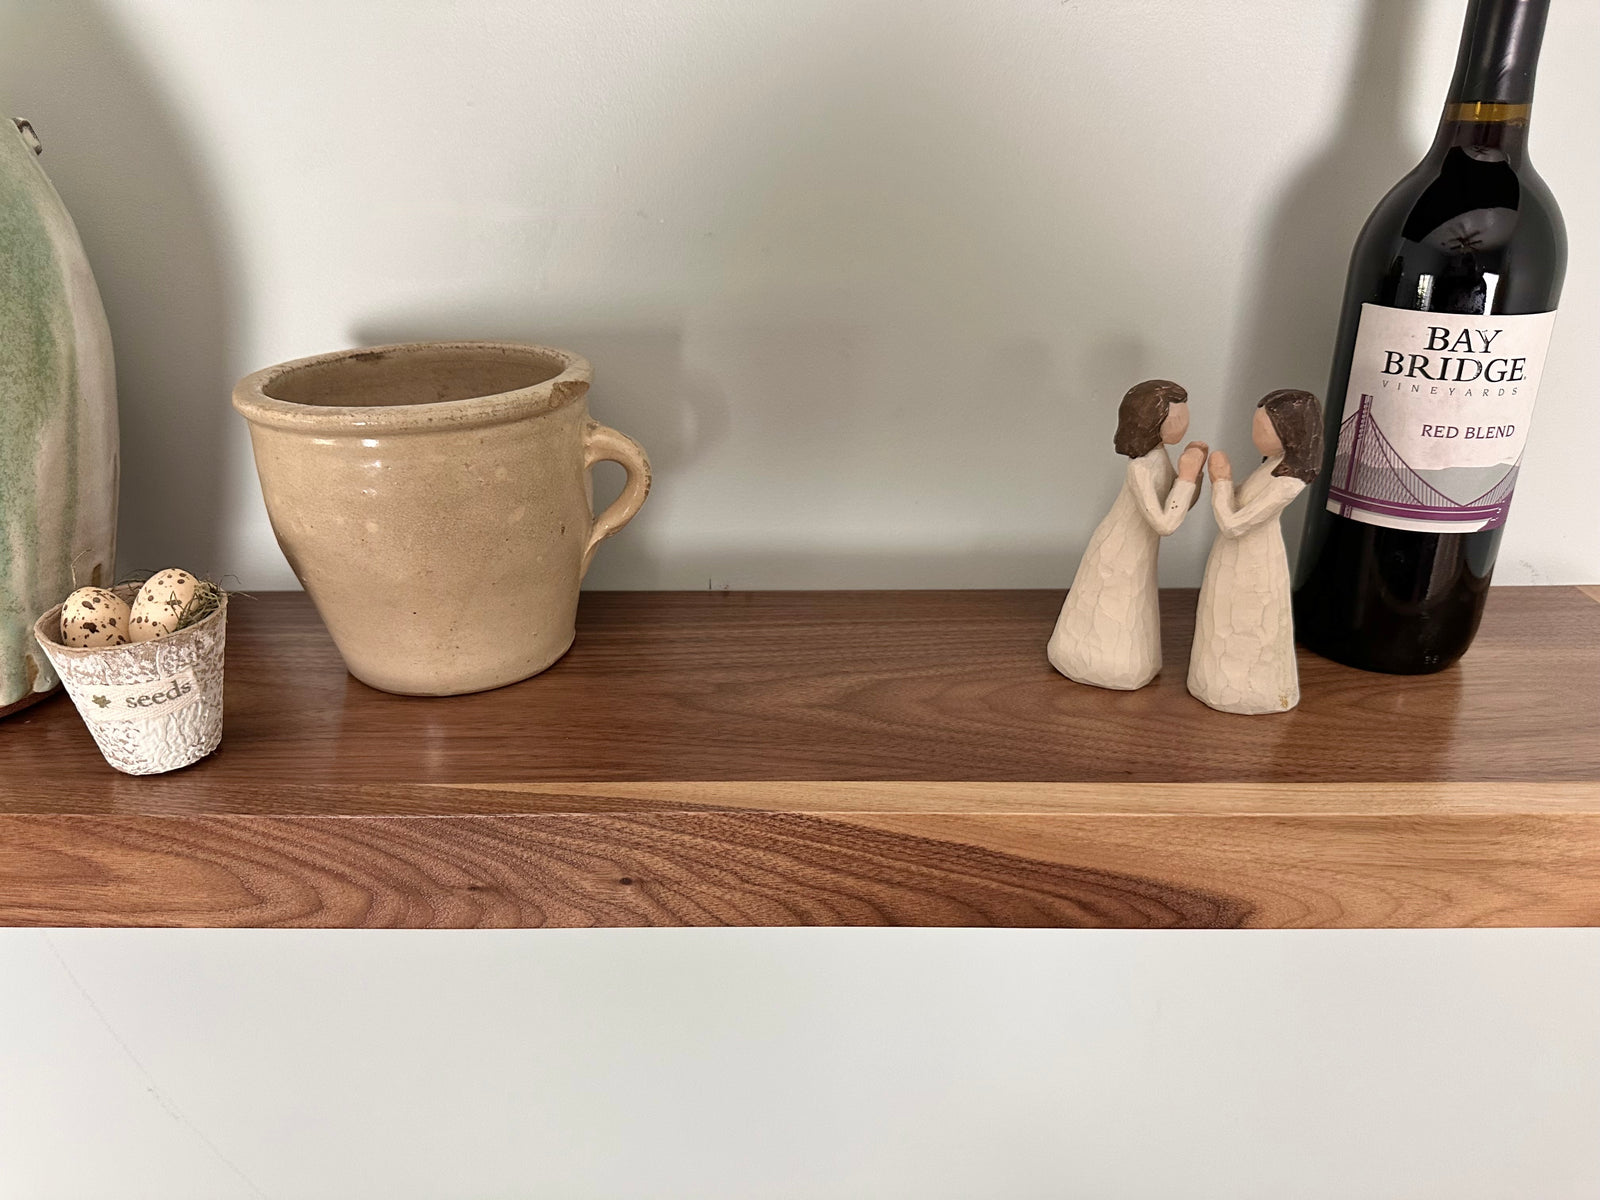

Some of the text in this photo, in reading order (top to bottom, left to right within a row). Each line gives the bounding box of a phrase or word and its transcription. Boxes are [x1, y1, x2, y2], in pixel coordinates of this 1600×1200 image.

[1423, 326, 1503, 354] BAY
[1382, 351, 1526, 382] BRIDGE
[1382, 380, 1518, 397] VINEYARDS
[1420, 424, 1515, 439] RED BLEND
[125, 679, 192, 709] seeds
